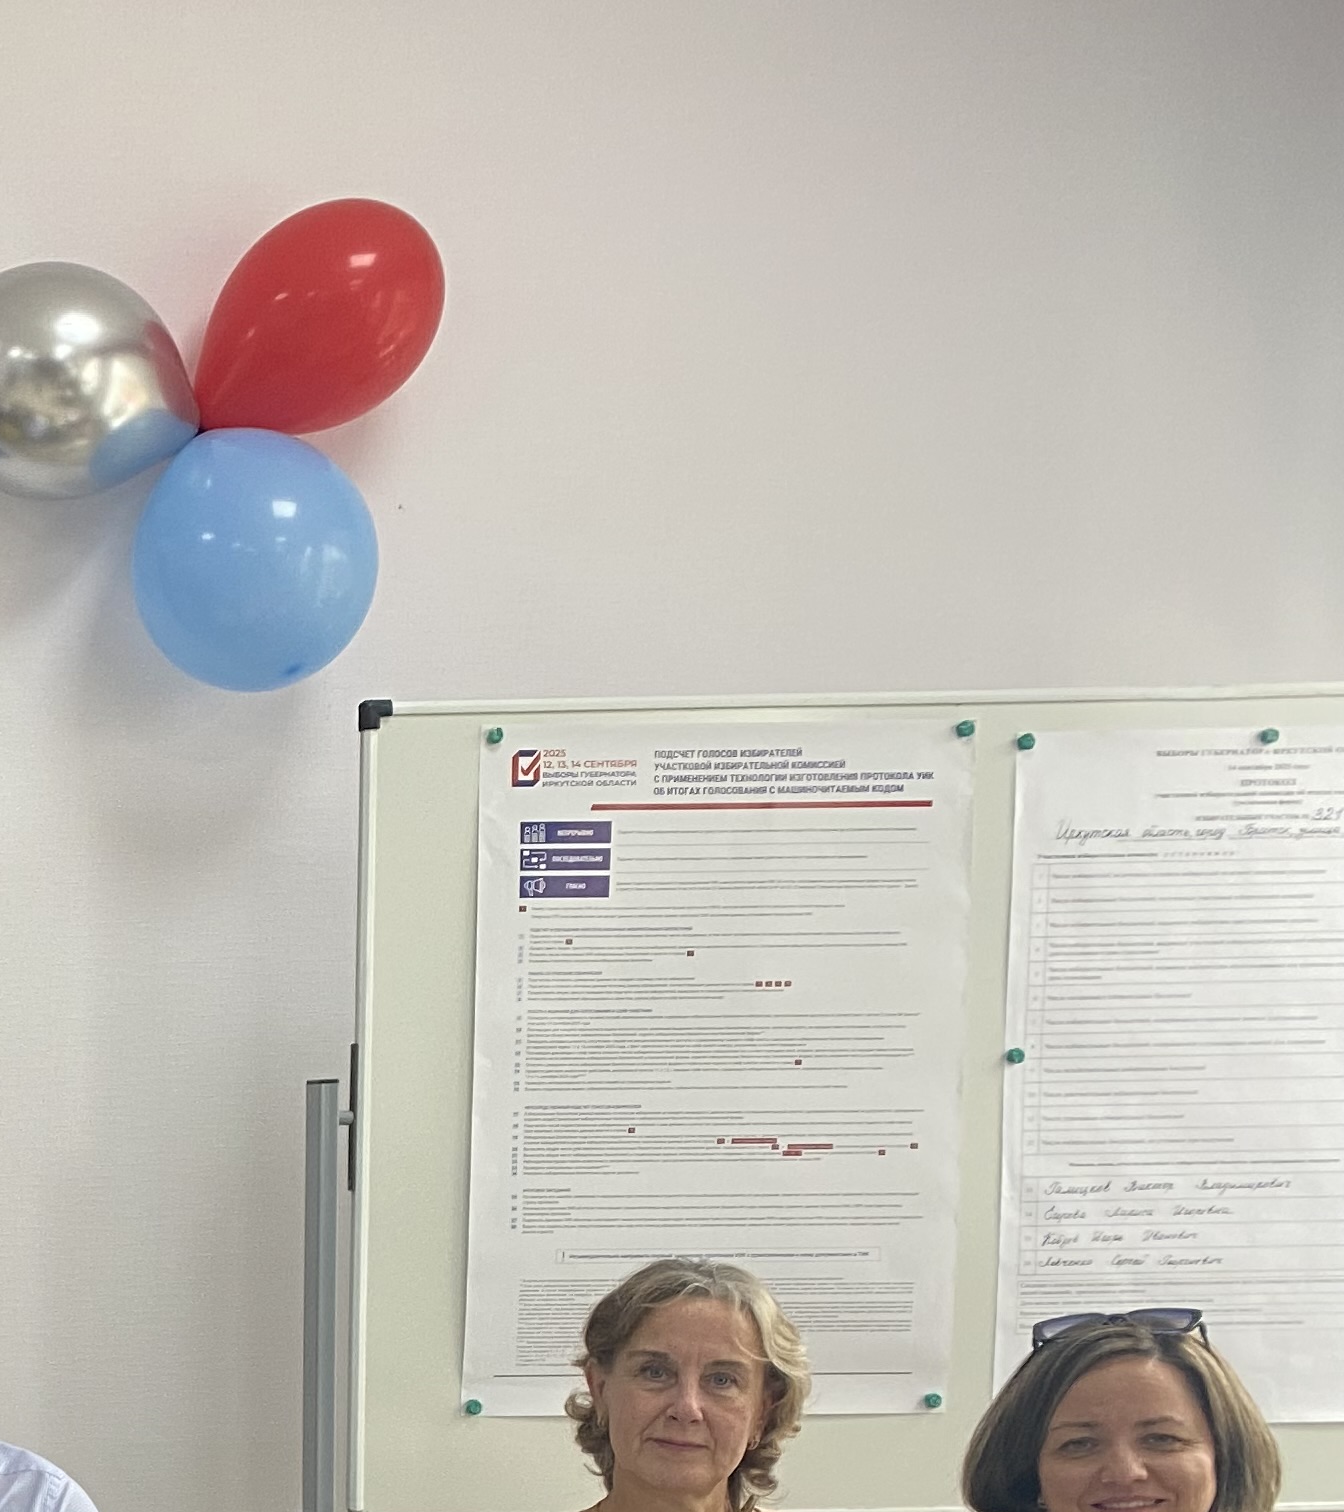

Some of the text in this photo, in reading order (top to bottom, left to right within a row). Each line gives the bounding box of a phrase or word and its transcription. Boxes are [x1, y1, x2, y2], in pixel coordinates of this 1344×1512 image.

[543, 749, 566, 758] 2025
[654, 747, 802, 759] ПОДСЧЕТ ГОЛОСОВ ИЗБИРАТЕЛЕЙ
[571, 760, 581, 768] 14
[584, 760, 637, 768] СЕНТЯБРЯ
[654, 759, 845, 770] УЧАСТКОВОЙ ИЗБИРАТЕЛЬНОЙ КОМИССИЕЙ
[654, 775, 660, 783] С
[662, 774, 727, 783] ПРИМЕНЕНИЕМ
[730, 773, 787, 782] ТЕХНОЛОГИИ
[789, 772, 858, 781] ИЗГОТОВЛЕНИЯ
[860, 771, 914, 780] ПРОТОКОЛА
[542, 779, 637, 787] ИРКУТСКОЙ ОБЛАСТИ
[653, 787, 665, 795] ОБ
[667, 786, 701, 796] ИТОГАХ
[703, 786, 767, 795] ГОЛОСОВАНИЯ
[769, 786, 775, 794] С
[872, 784, 904, 793] КОДОМ
